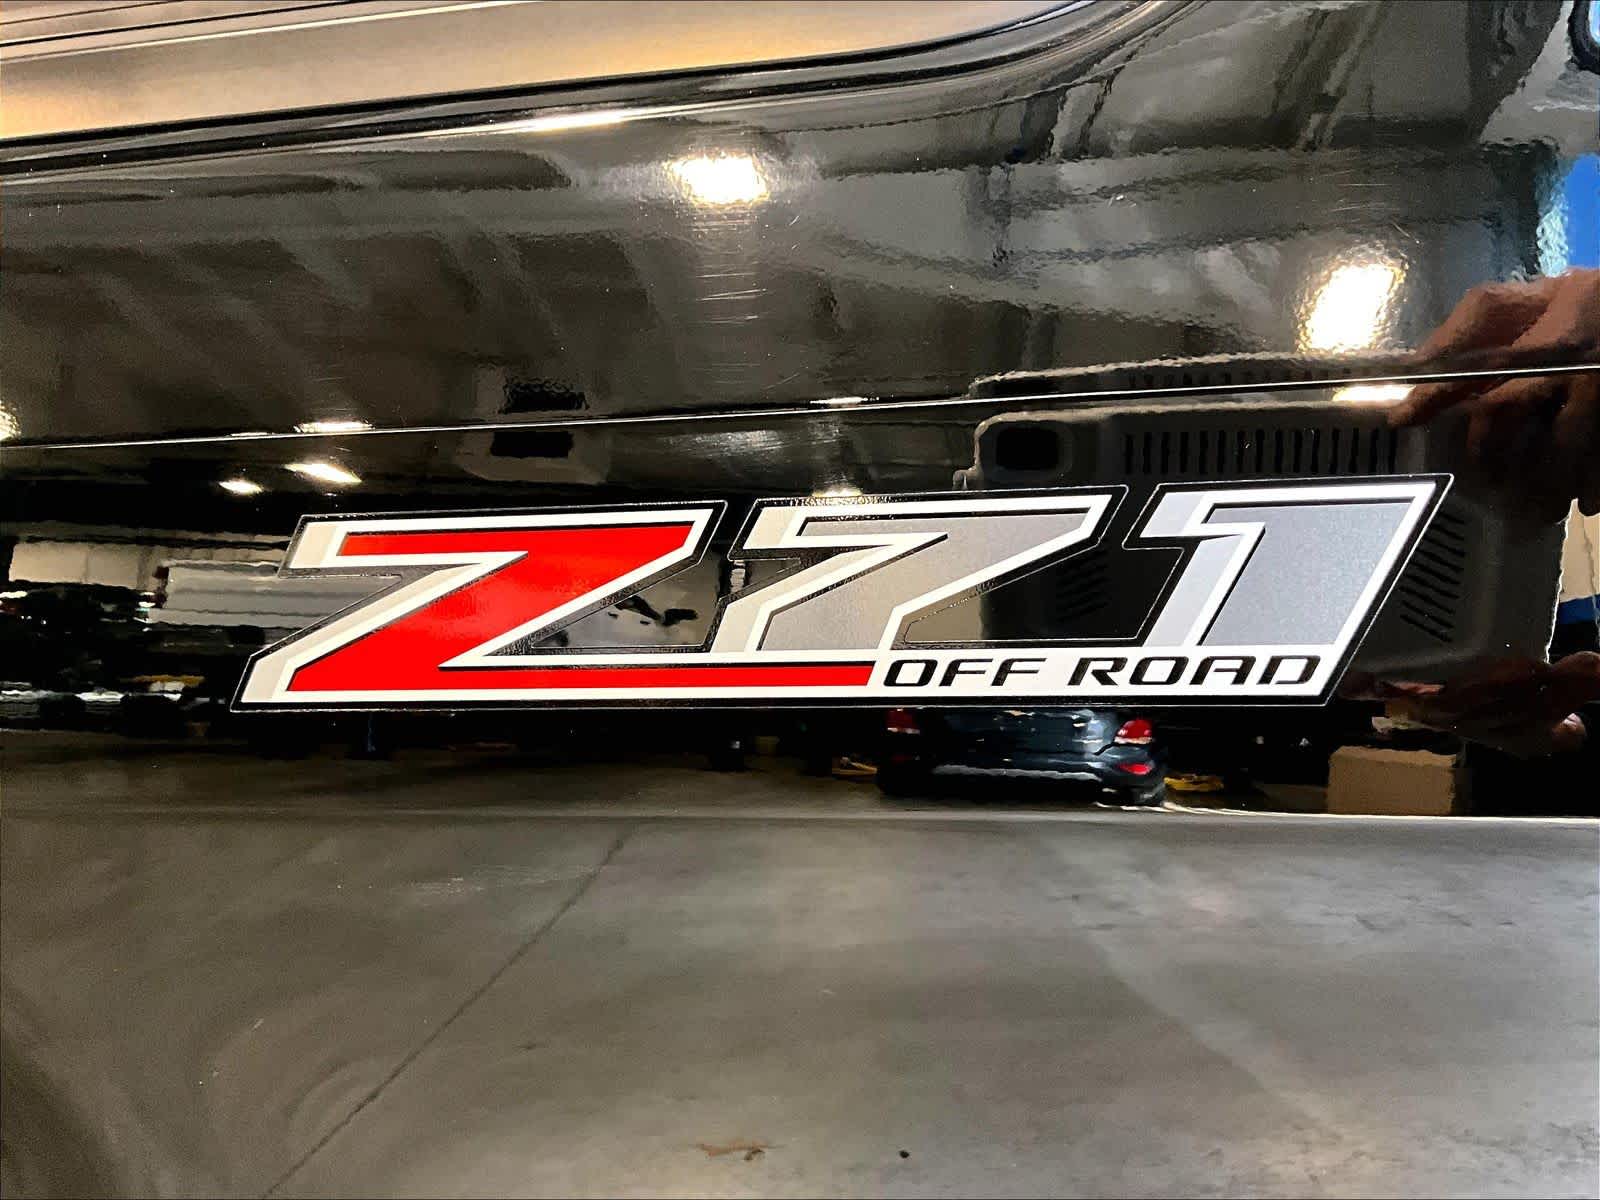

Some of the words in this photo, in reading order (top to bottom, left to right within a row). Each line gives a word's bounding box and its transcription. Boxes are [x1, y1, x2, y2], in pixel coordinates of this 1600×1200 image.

[239, 481, 1439, 704] Z71
[883, 657, 1047, 688] OFF
[1067, 655, 1321, 686] ROAD
